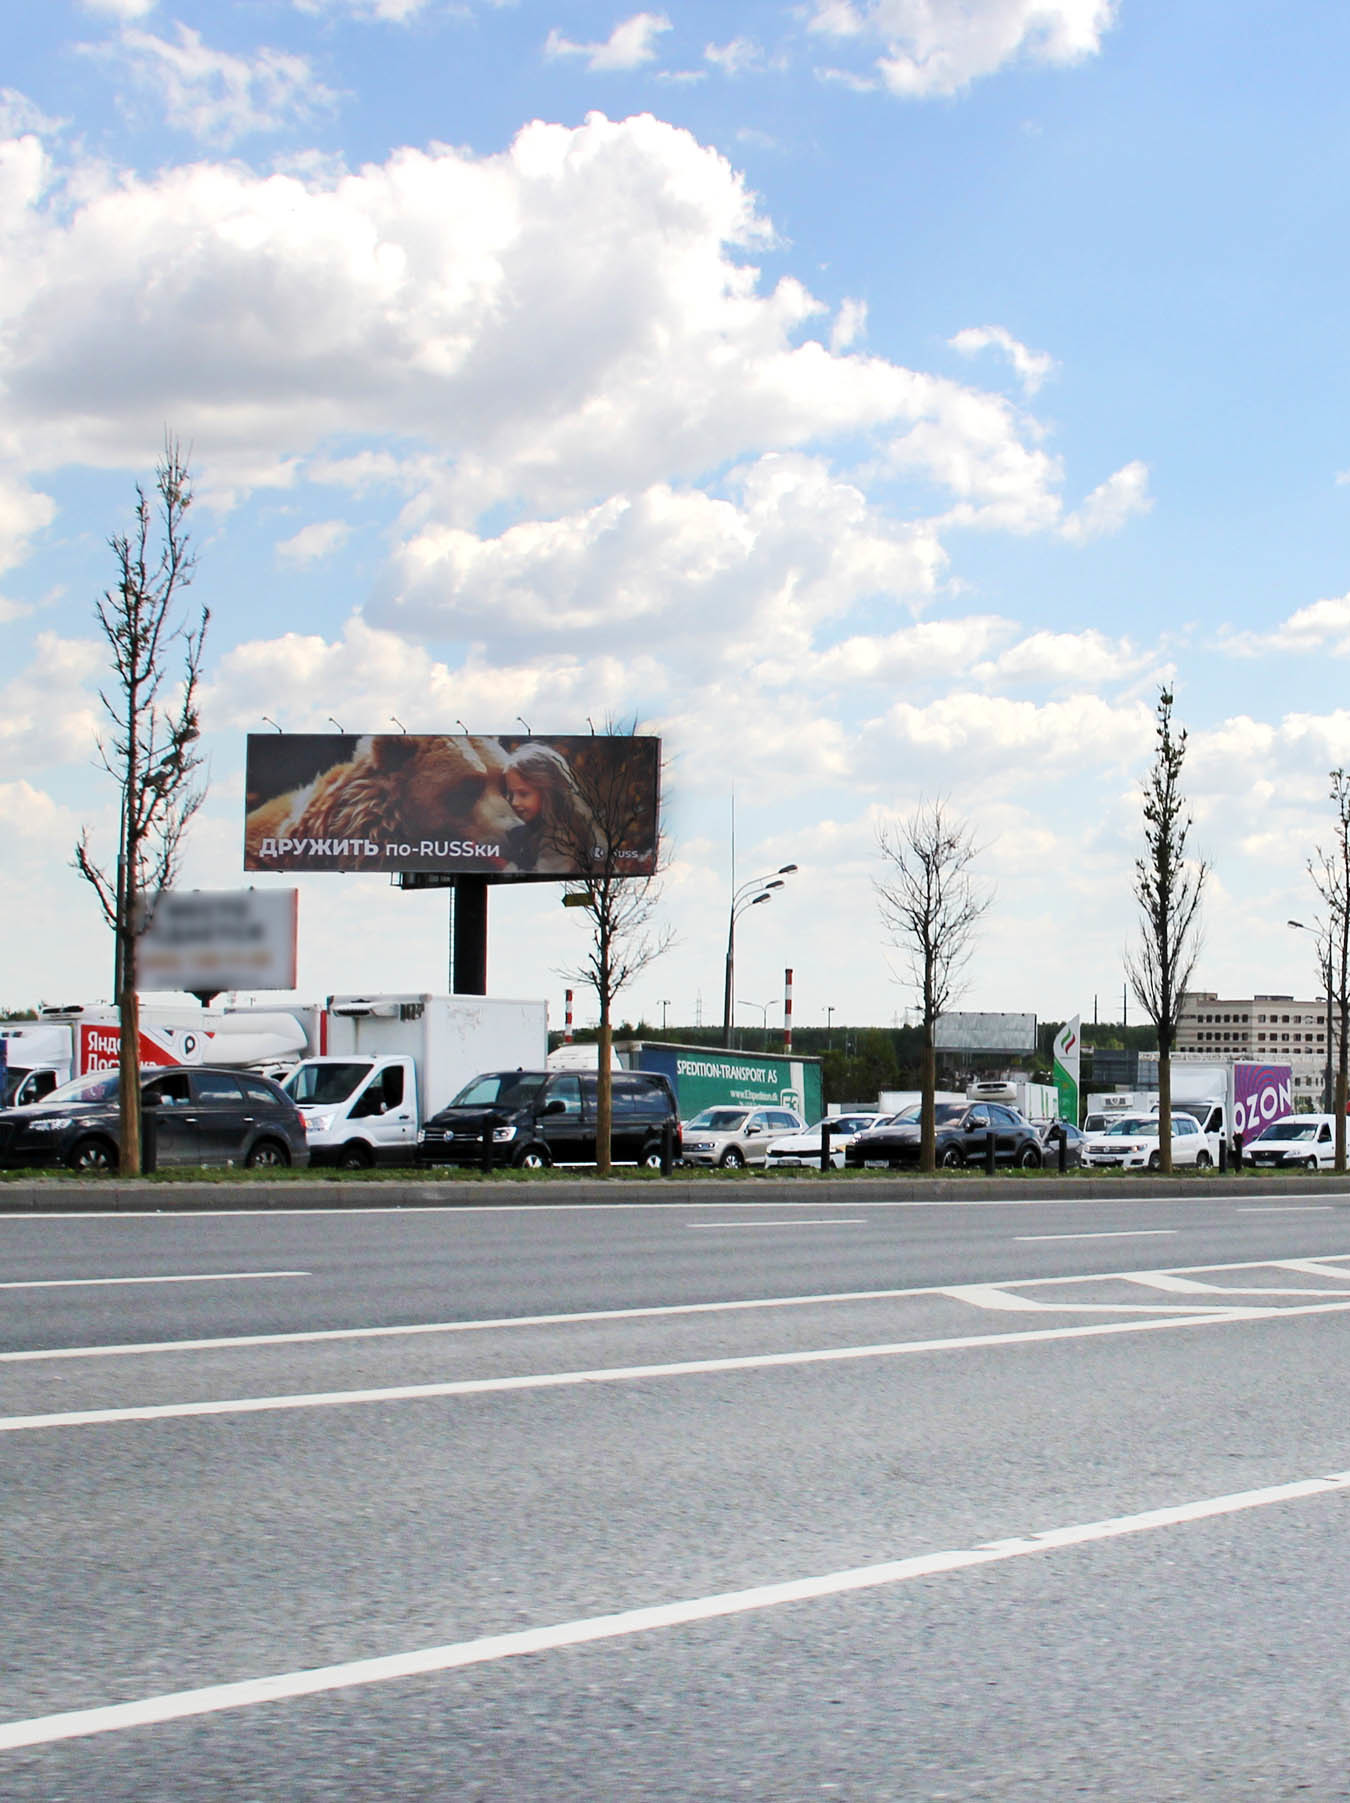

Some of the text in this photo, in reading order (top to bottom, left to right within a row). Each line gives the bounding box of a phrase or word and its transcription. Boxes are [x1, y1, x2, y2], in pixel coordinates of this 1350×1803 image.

[259, 838, 500, 858] ДРУЖИТЬ по-RUSSки
[676, 1060, 766, 1083] SPEDITION-TRANSPORT
[1233, 1078, 1292, 1133] OZON
